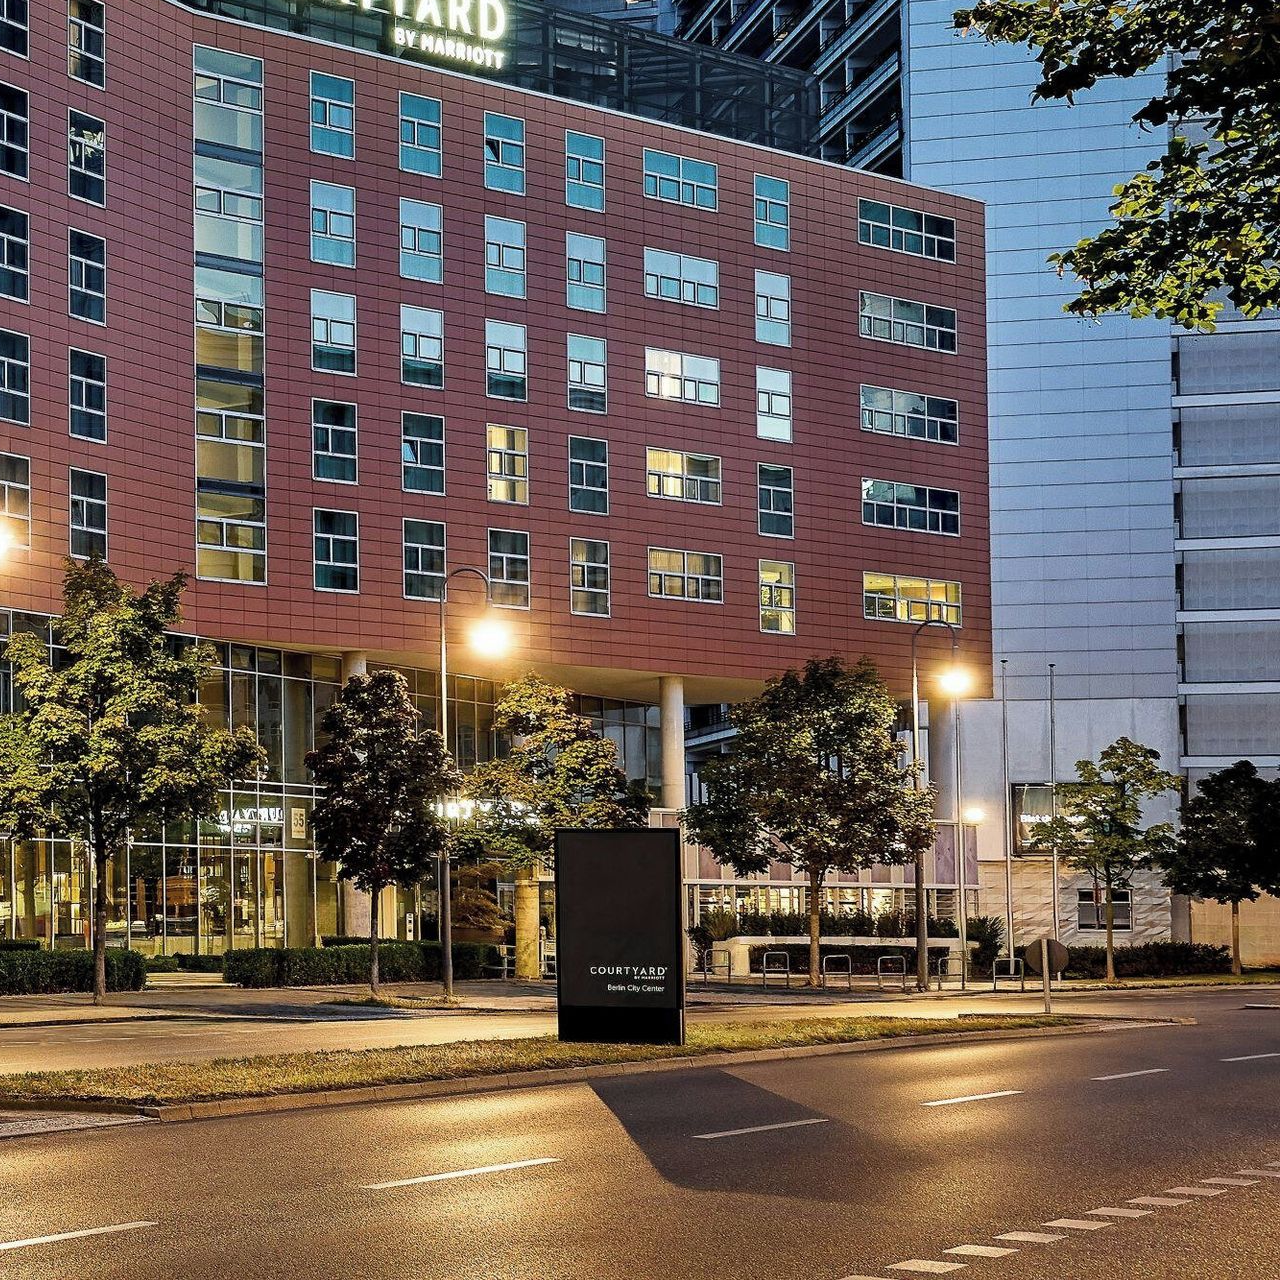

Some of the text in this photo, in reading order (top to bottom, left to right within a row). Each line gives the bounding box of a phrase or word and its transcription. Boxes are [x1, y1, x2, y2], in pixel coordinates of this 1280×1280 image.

[394, 27, 504, 70] BY MARRIOTT
[590, 966, 666, 976] COURTYARD
[627, 984, 641, 992] City
